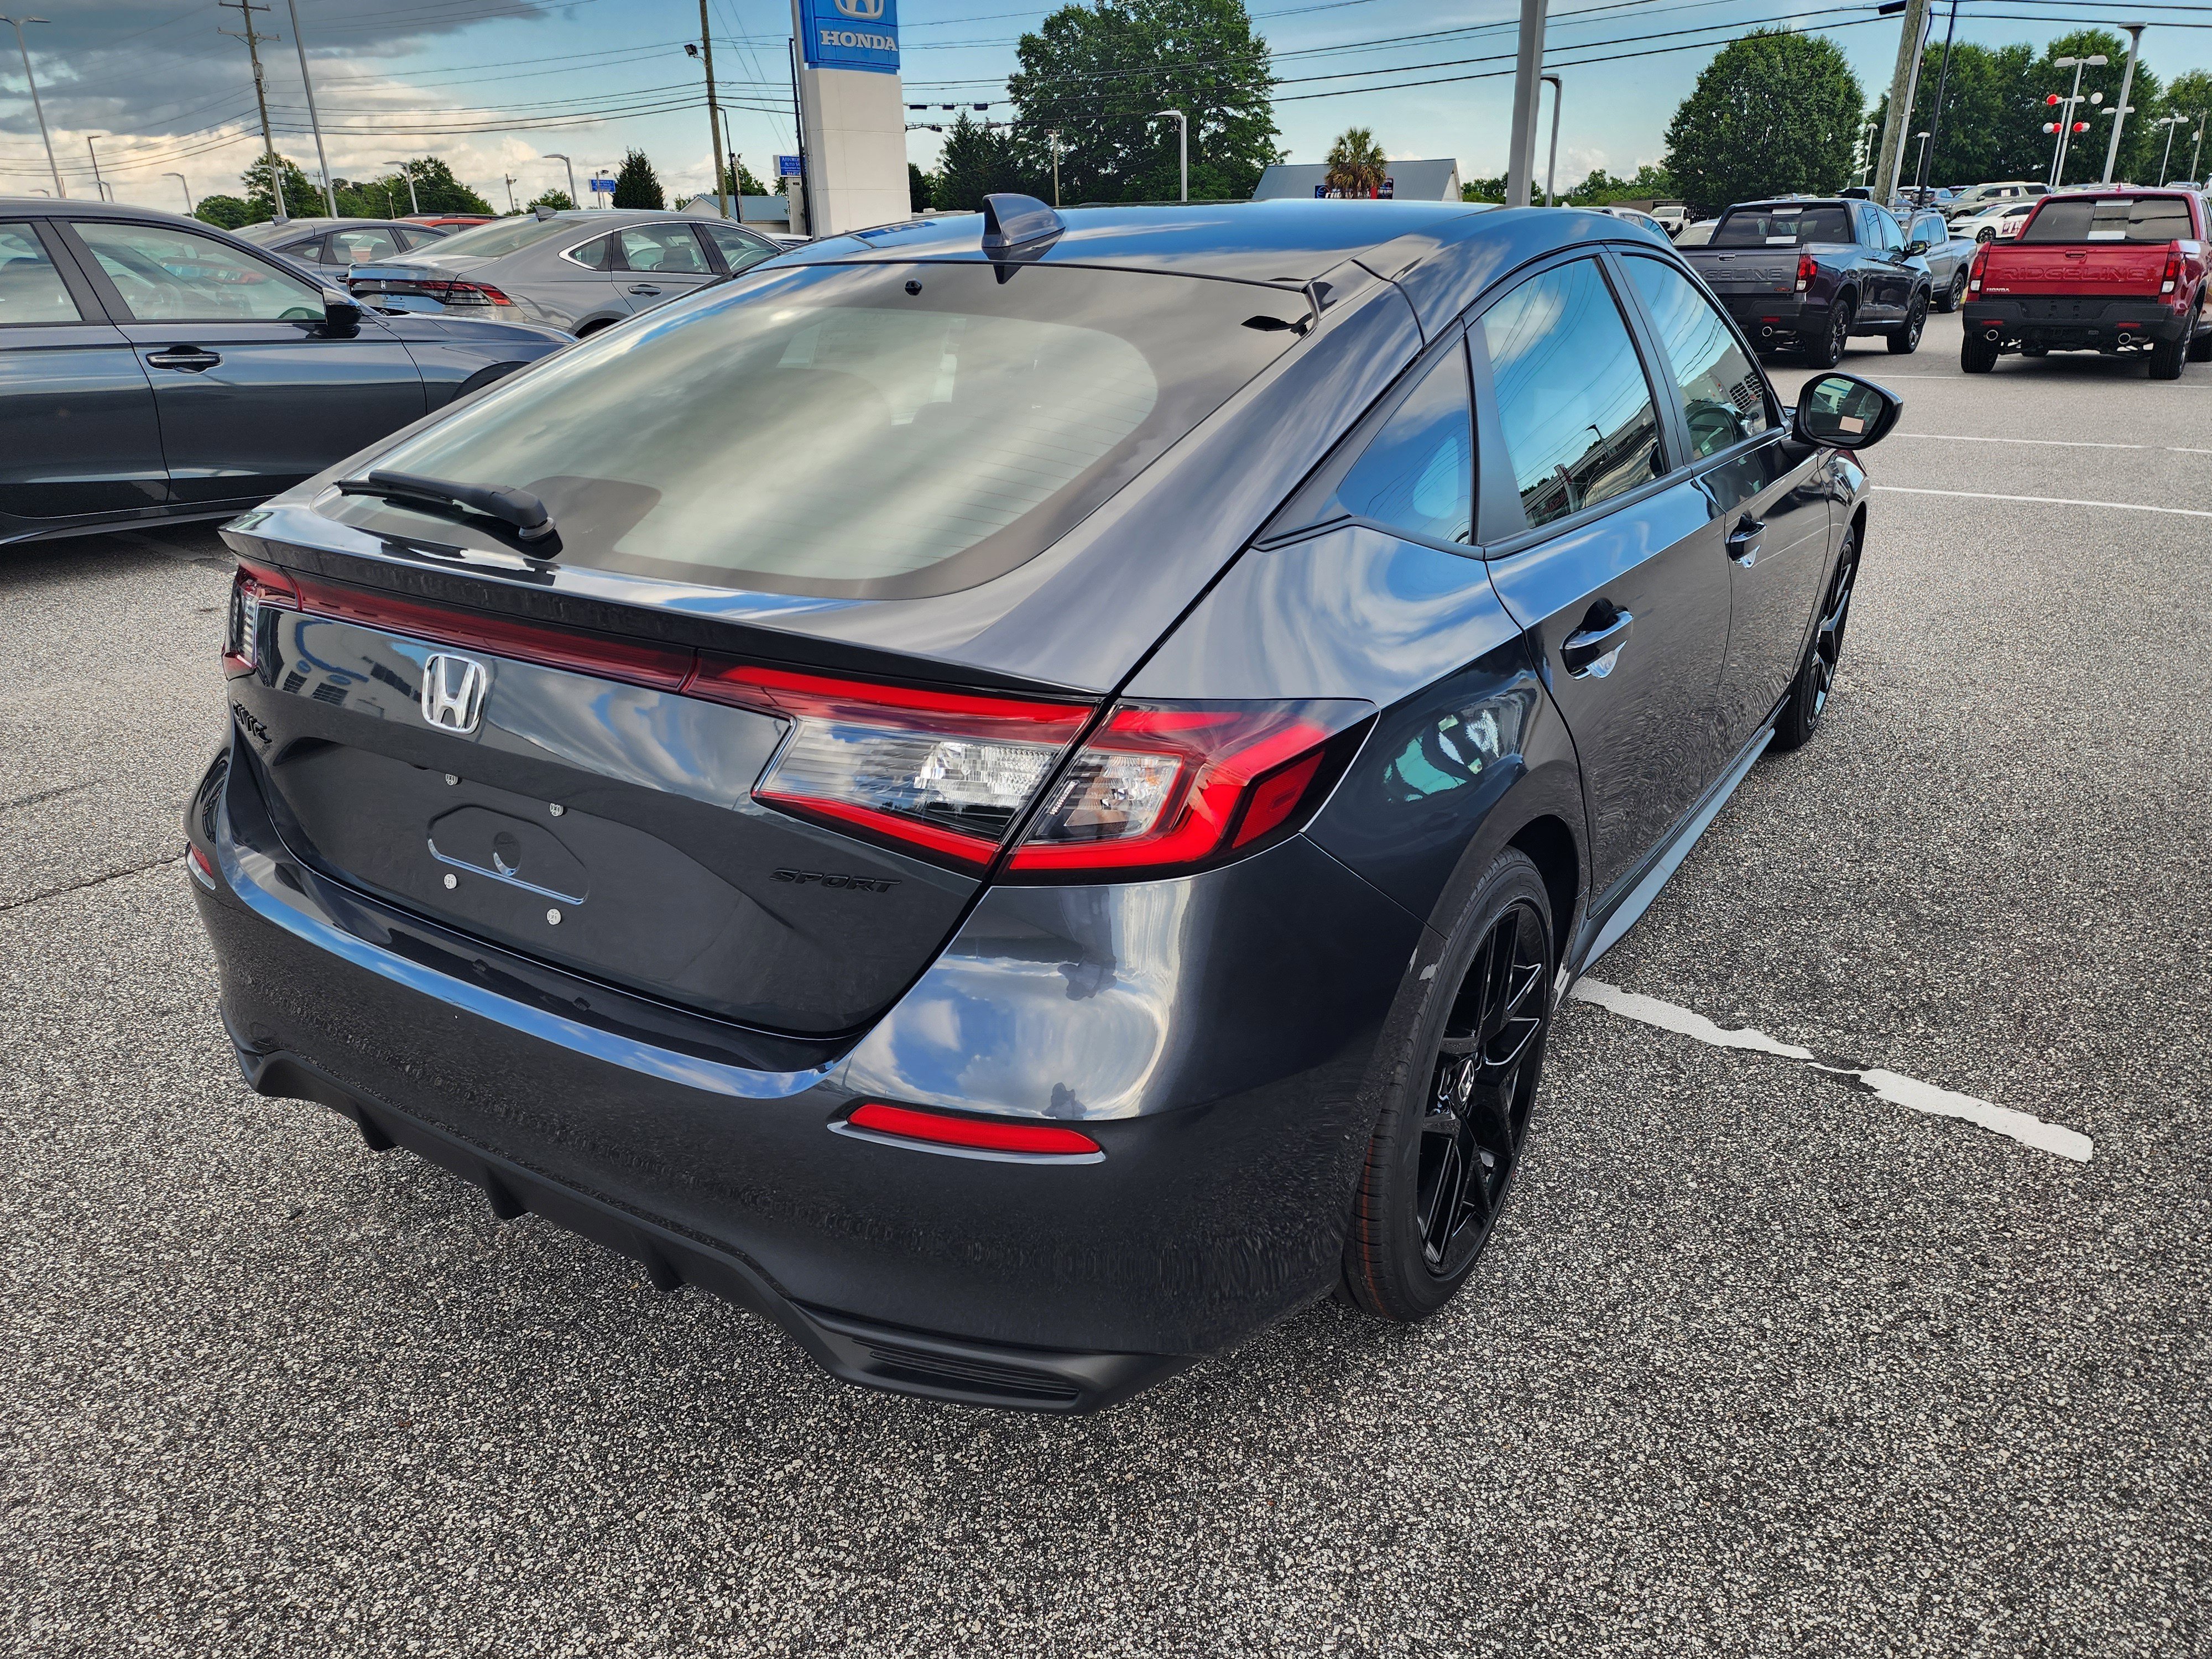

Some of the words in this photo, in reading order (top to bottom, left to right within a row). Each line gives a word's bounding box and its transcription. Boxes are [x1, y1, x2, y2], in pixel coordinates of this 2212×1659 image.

[820, 30, 899, 51] HONDA
[1697, 269, 1782, 280] GELINE
[2000, 267, 2146, 281] RIDGELINE
[769, 867, 902, 893] SPORT
